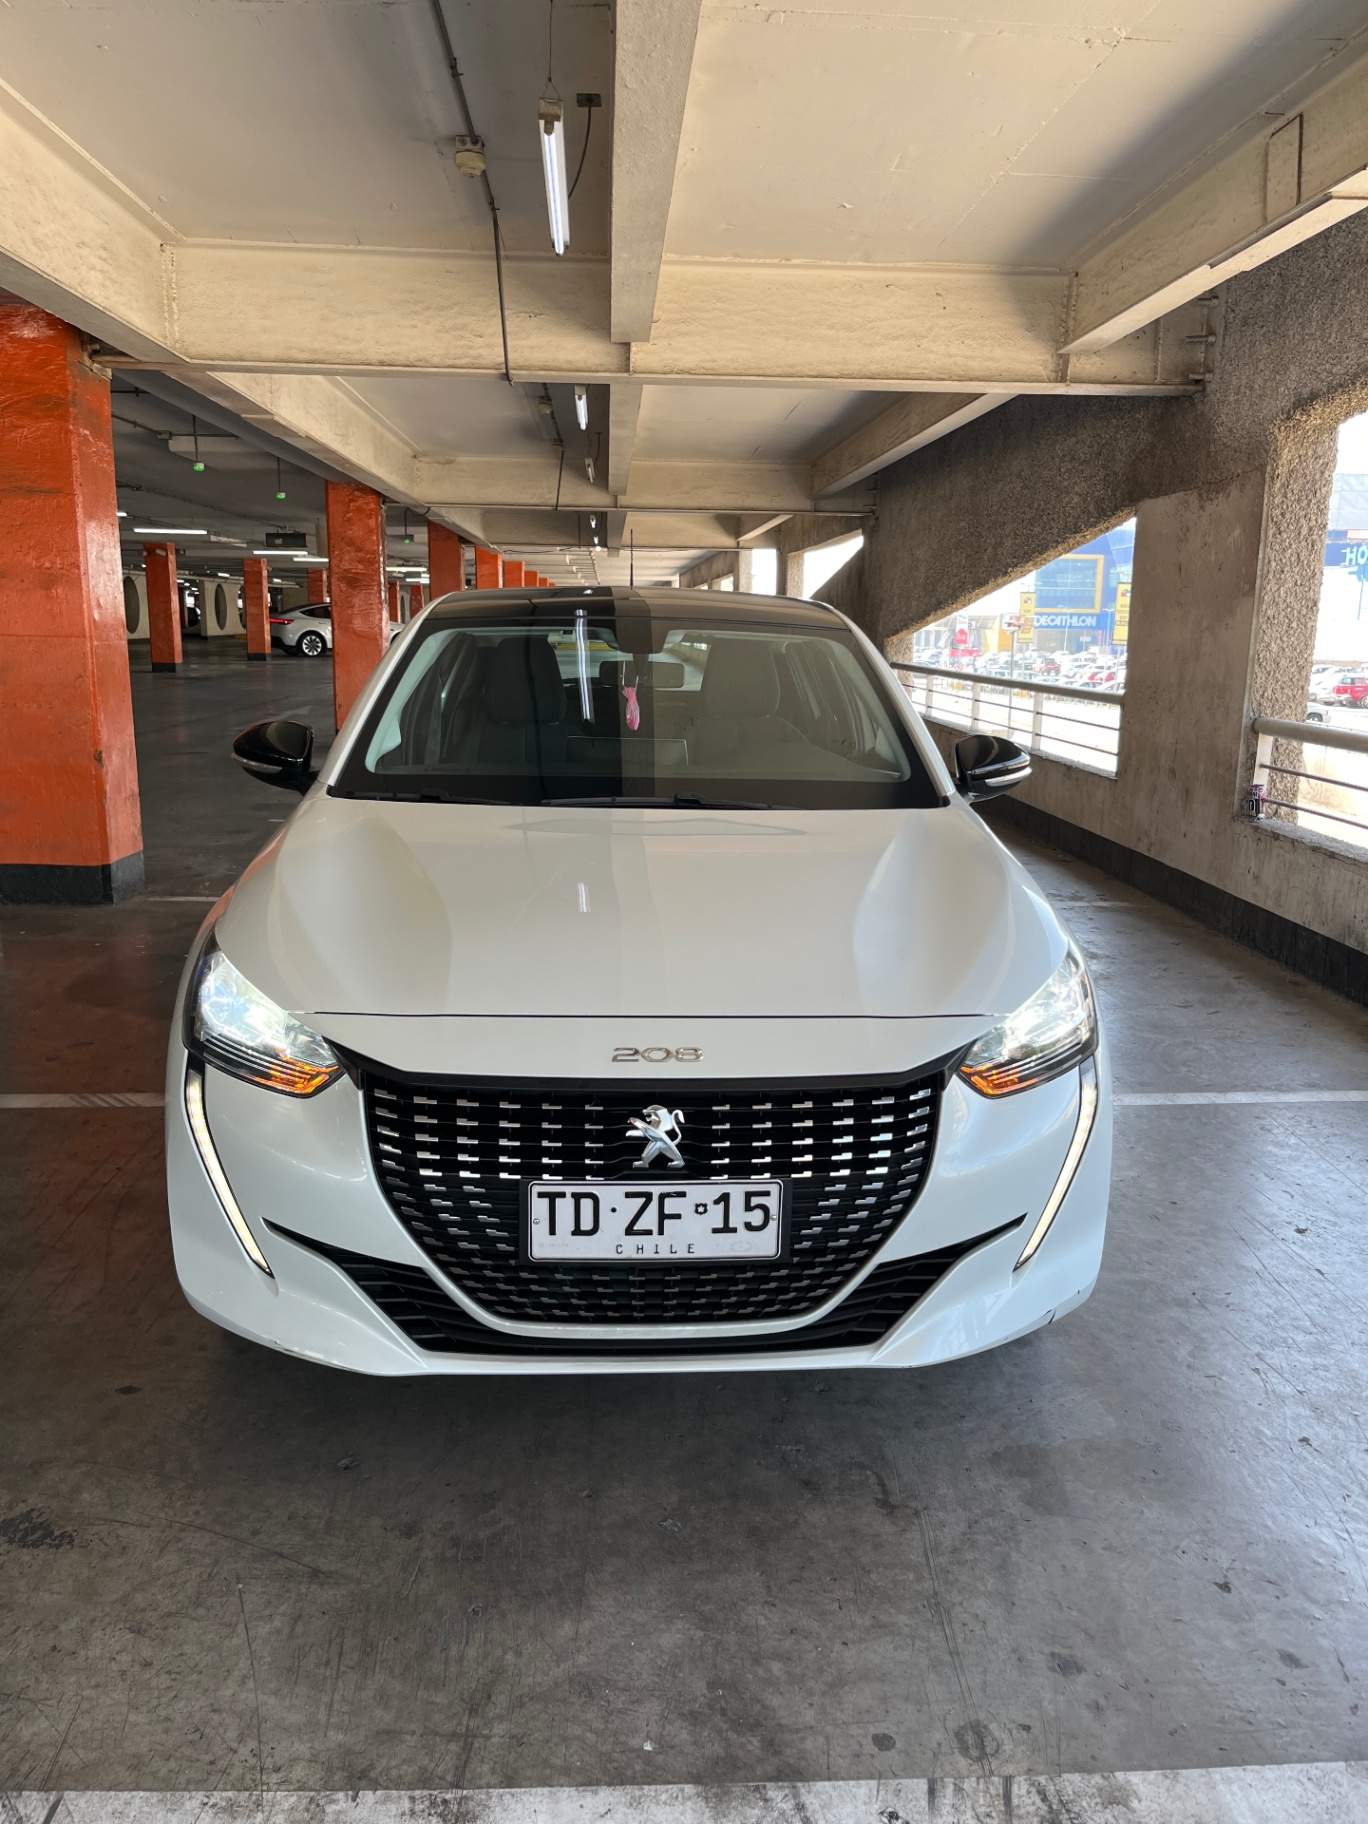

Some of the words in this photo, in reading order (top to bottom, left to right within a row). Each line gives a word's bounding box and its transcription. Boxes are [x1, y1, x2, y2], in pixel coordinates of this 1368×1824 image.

[1034, 614, 1097, 628] DECATHLON
[612, 1047, 703, 1062] 208
[615, 1243, 696, 1255] CHILE
